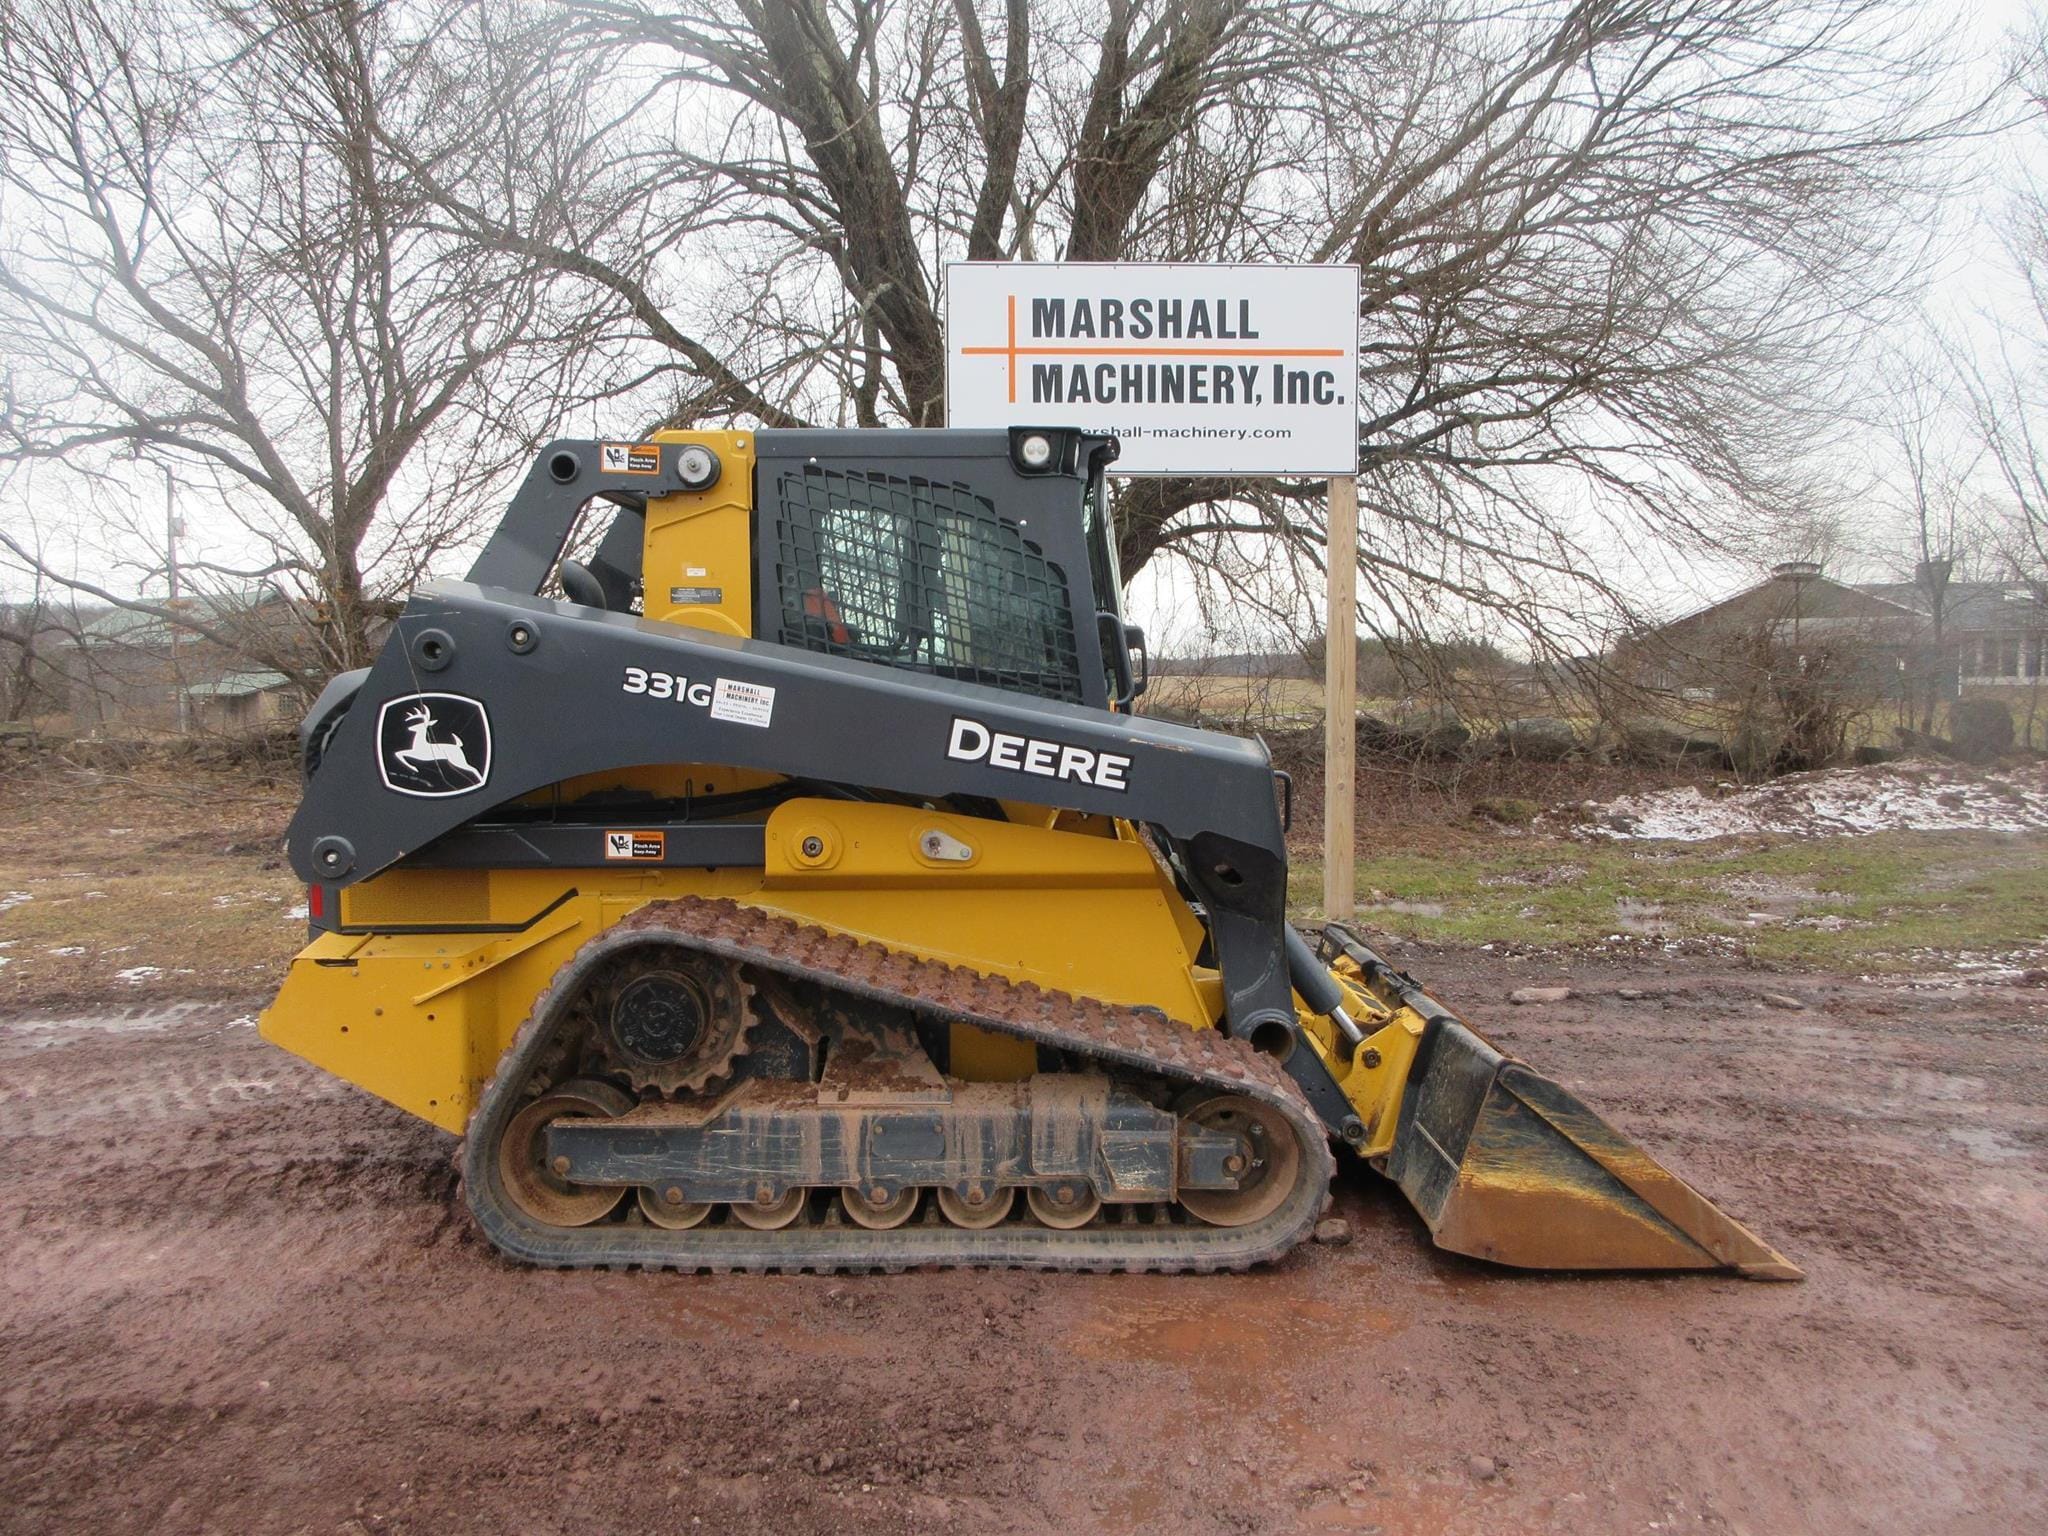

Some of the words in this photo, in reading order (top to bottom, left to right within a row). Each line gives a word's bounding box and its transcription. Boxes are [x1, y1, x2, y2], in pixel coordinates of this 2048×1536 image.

[1032, 298, 1259, 339] MARSHALL
[1032, 364, 1262, 406] MACHINERY,
[1273, 364, 1345, 405] Inc.
[1082, 426, 1292, 440] arshall-machinery.com
[622, 667, 713, 707] 331G
[947, 718, 1131, 790] DEERE
